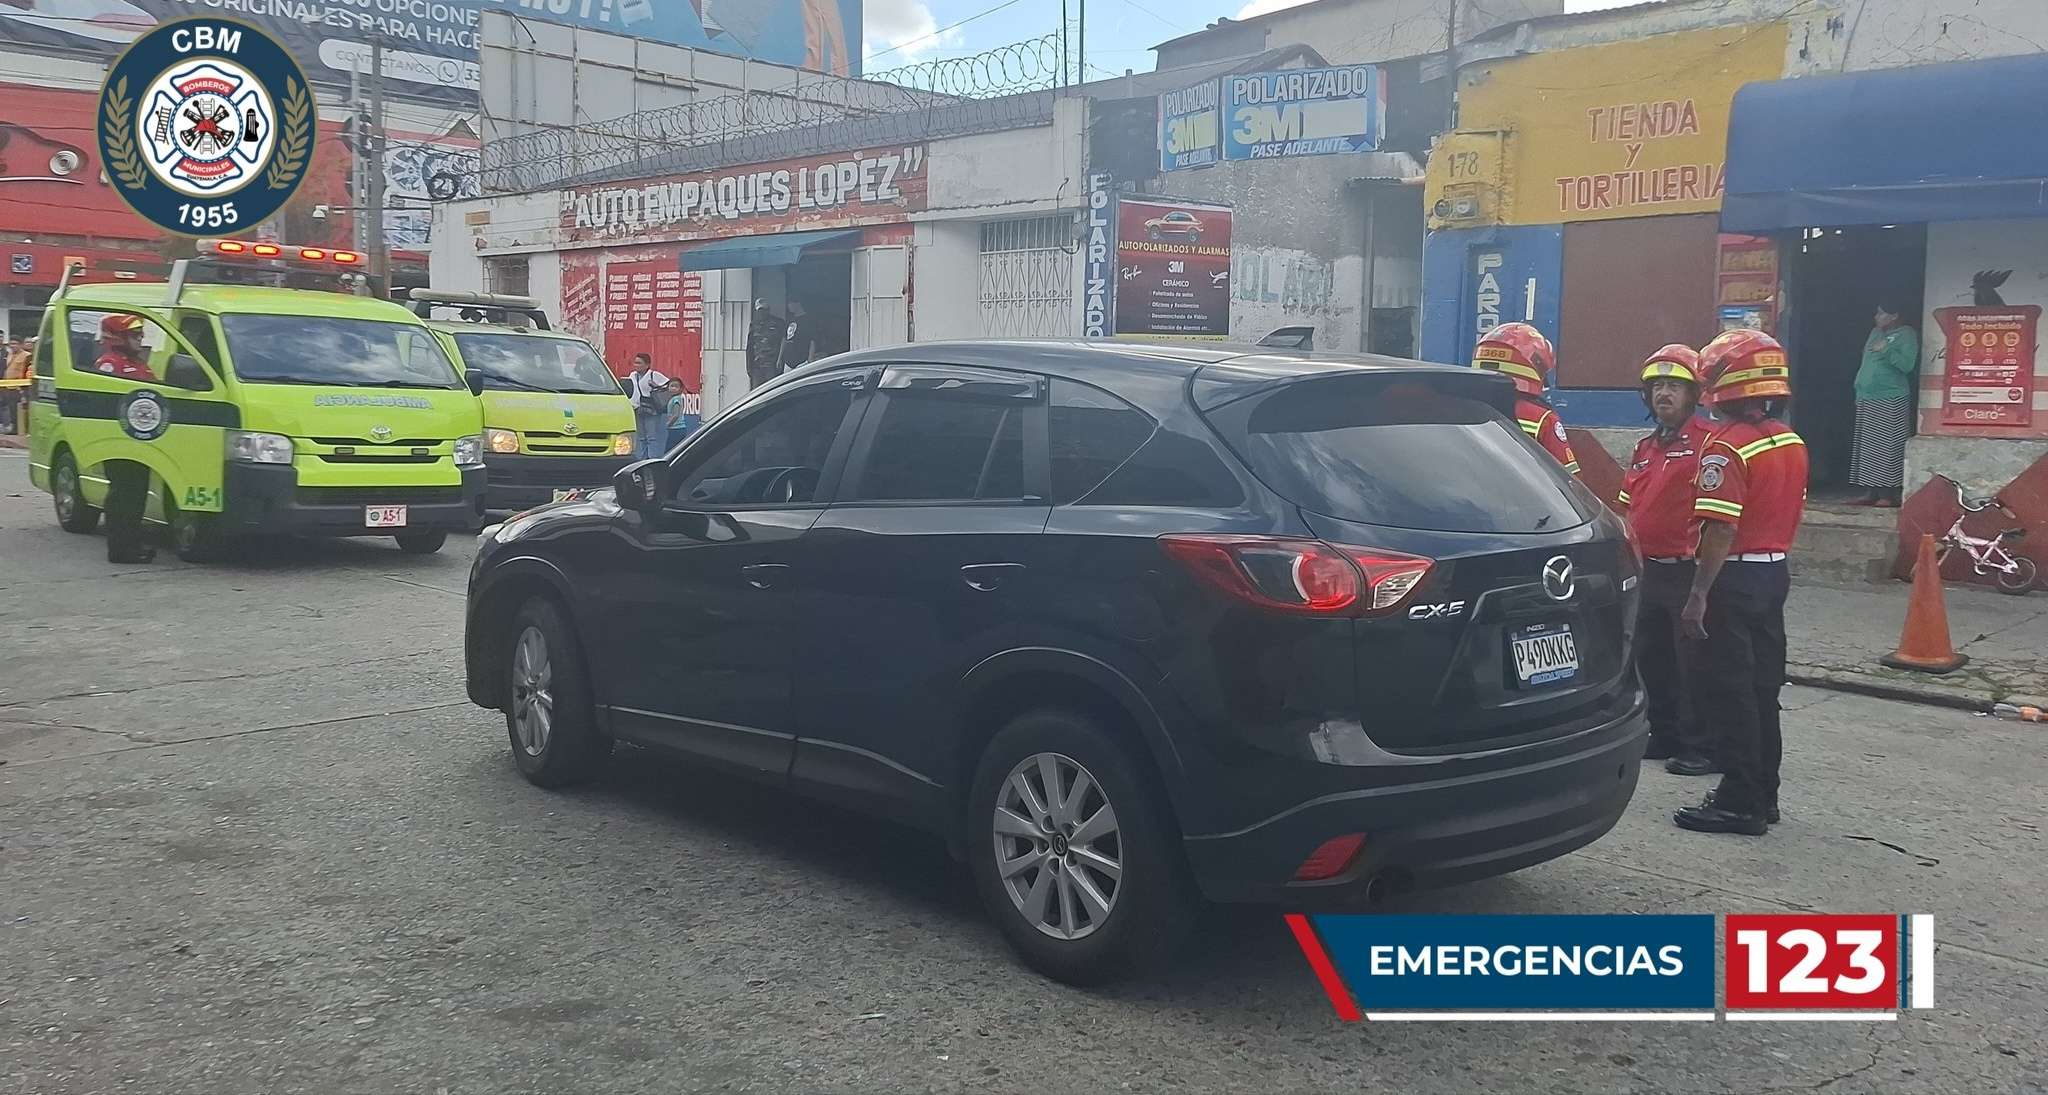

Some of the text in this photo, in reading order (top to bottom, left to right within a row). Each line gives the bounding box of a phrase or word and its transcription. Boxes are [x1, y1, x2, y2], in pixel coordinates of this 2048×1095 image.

[1166, 81, 1216, 118] POLARIZADO
[1232, 67, 1368, 106] POLARIZADO
[1232, 105, 1303, 145] 3M
[1587, 98, 1699, 142] TIENDA
[1176, 153, 1191, 168] PASE
[1250, 137, 1347, 159] PASE ADELANTE
[1624, 142, 1642, 169] Y
[643, 170, 791, 221] EMPAQUES
[1556, 162, 1726, 211] TORTILLERIA
[1086, 174, 1110, 337] POLARIZADO
[1119, 240, 1230, 256] AUTOPOLARIZADOS Y ALARMAS
[1168, 261, 1184, 273] 3M
[1477, 253, 1502, 345] PARQ
[1965, 408, 1999, 420] Claro
[184, 486, 222, 508] A5-1
[1408, 600, 1465, 620] CX-5
